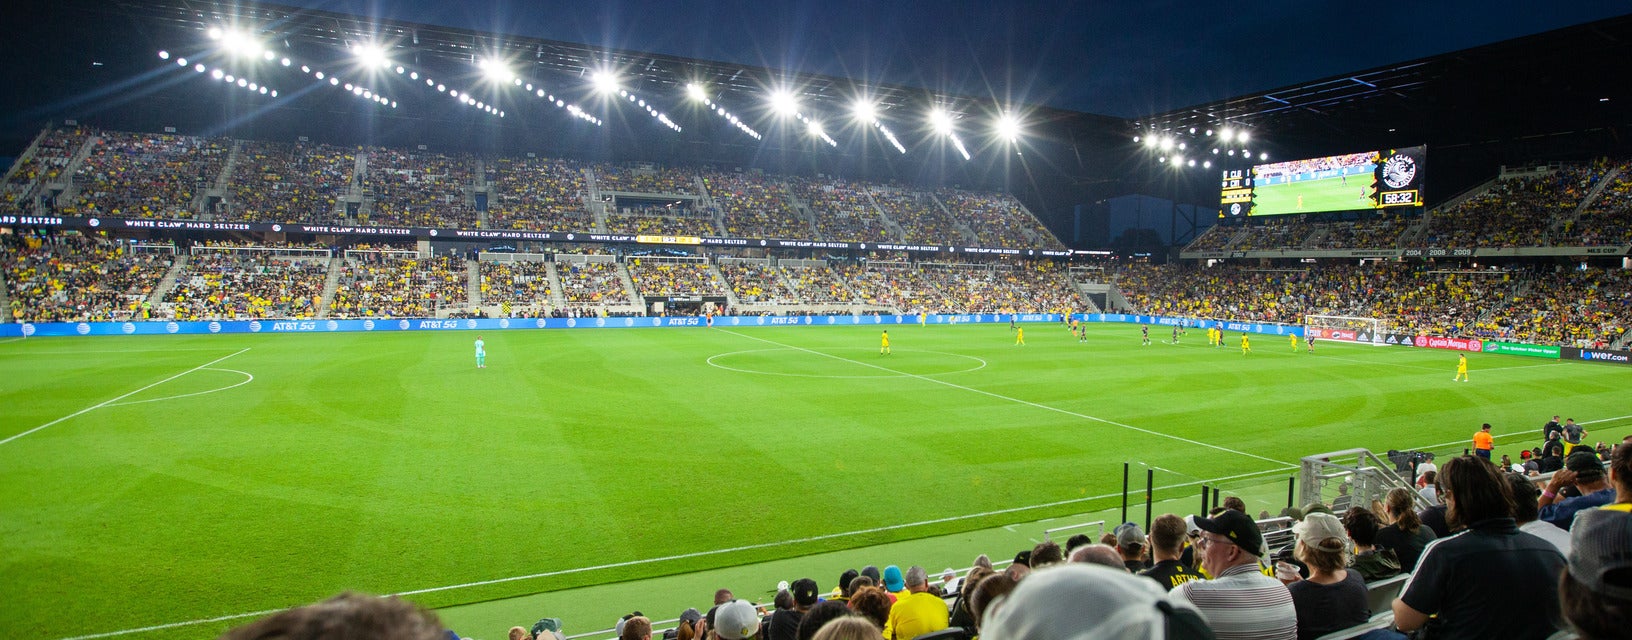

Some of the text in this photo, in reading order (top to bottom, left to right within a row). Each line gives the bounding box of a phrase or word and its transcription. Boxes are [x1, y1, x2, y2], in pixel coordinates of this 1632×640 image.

[1385, 192, 1413, 204] 58:32
[0, 215, 63, 225] RD SELTZER
[125, 220, 155, 228] WHITE
[157, 221, 184, 229] CLAW
[214, 223, 250, 231] SELTZER
[379, 228, 411, 236] SELTZER
[419, 320, 458, 329] AT&T 5G
[668, 318, 699, 326] AT&T 5G
[771, 317, 799, 325] AT&T 5G
[273, 322, 316, 331] AT&T 5G
[1227, 323, 1241, 331] AT&T
[1428, 338, 1468, 350] Captain Morgan
